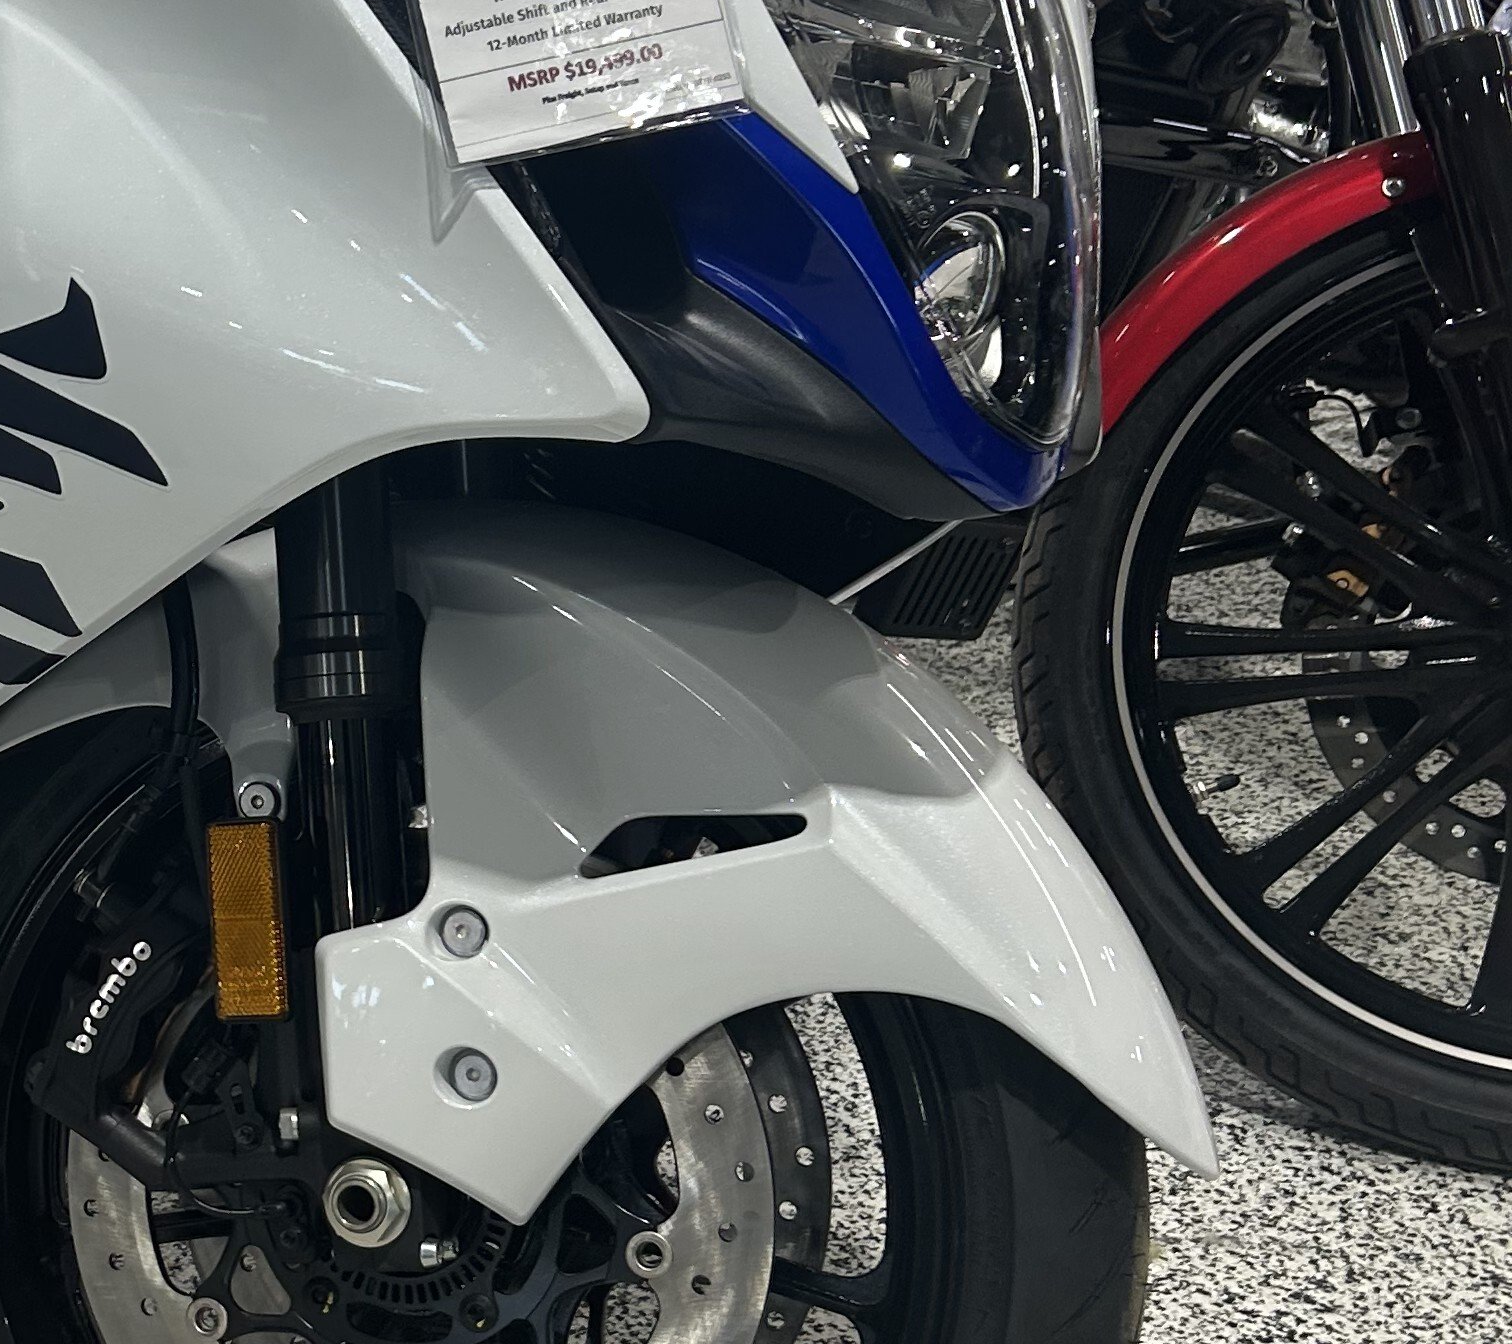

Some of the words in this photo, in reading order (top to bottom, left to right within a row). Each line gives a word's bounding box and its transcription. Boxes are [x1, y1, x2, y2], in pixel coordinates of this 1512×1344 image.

[444, 11, 515, 38] Adjustable
[517, 1, 550, 21] Shift
[487, 28, 549, 52] 12-Month
[604, 3, 663, 27] Warranty
[507, 66, 560, 92] MSRP
[65, 941, 152, 1054] brembo
